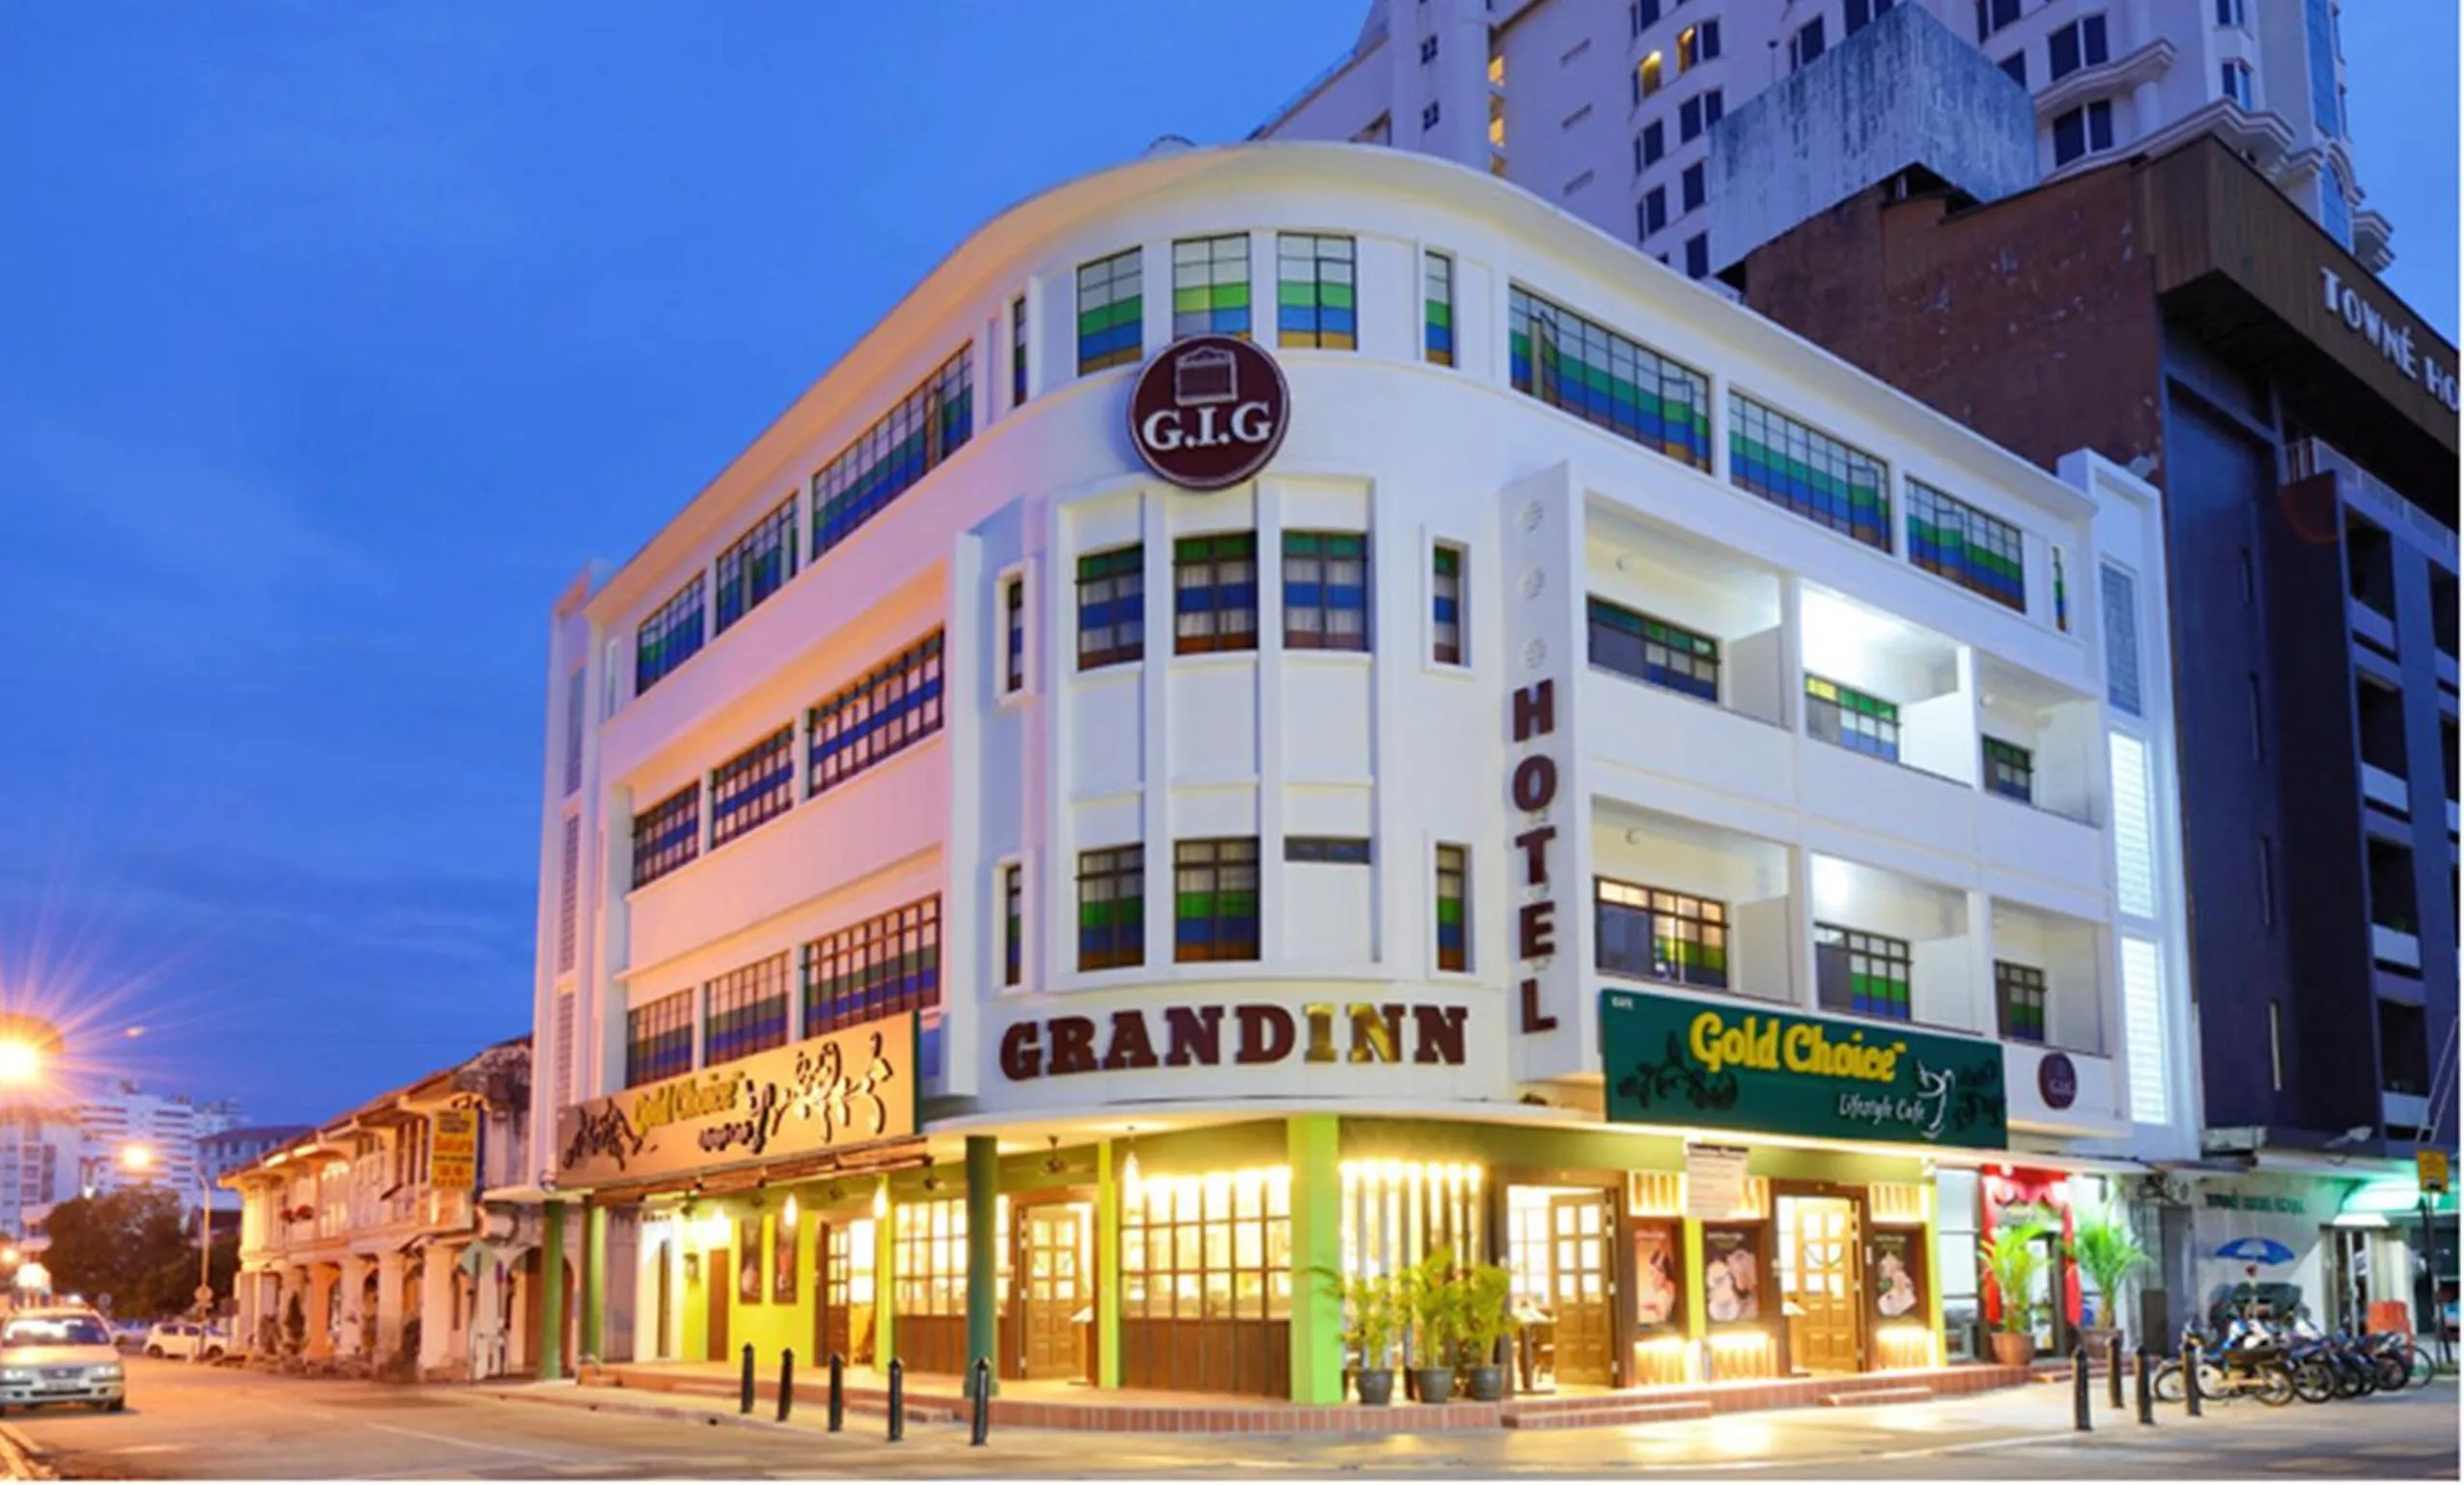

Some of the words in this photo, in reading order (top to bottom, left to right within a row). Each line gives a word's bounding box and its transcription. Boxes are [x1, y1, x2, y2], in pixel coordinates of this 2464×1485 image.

[1142, 401, 1273, 451] G.I.G
[1512, 679, 1557, 1034] HOTEL
[1691, 1011, 1779, 1073] Gold
[1839, 1092, 1892, 1125] Lifestyle
